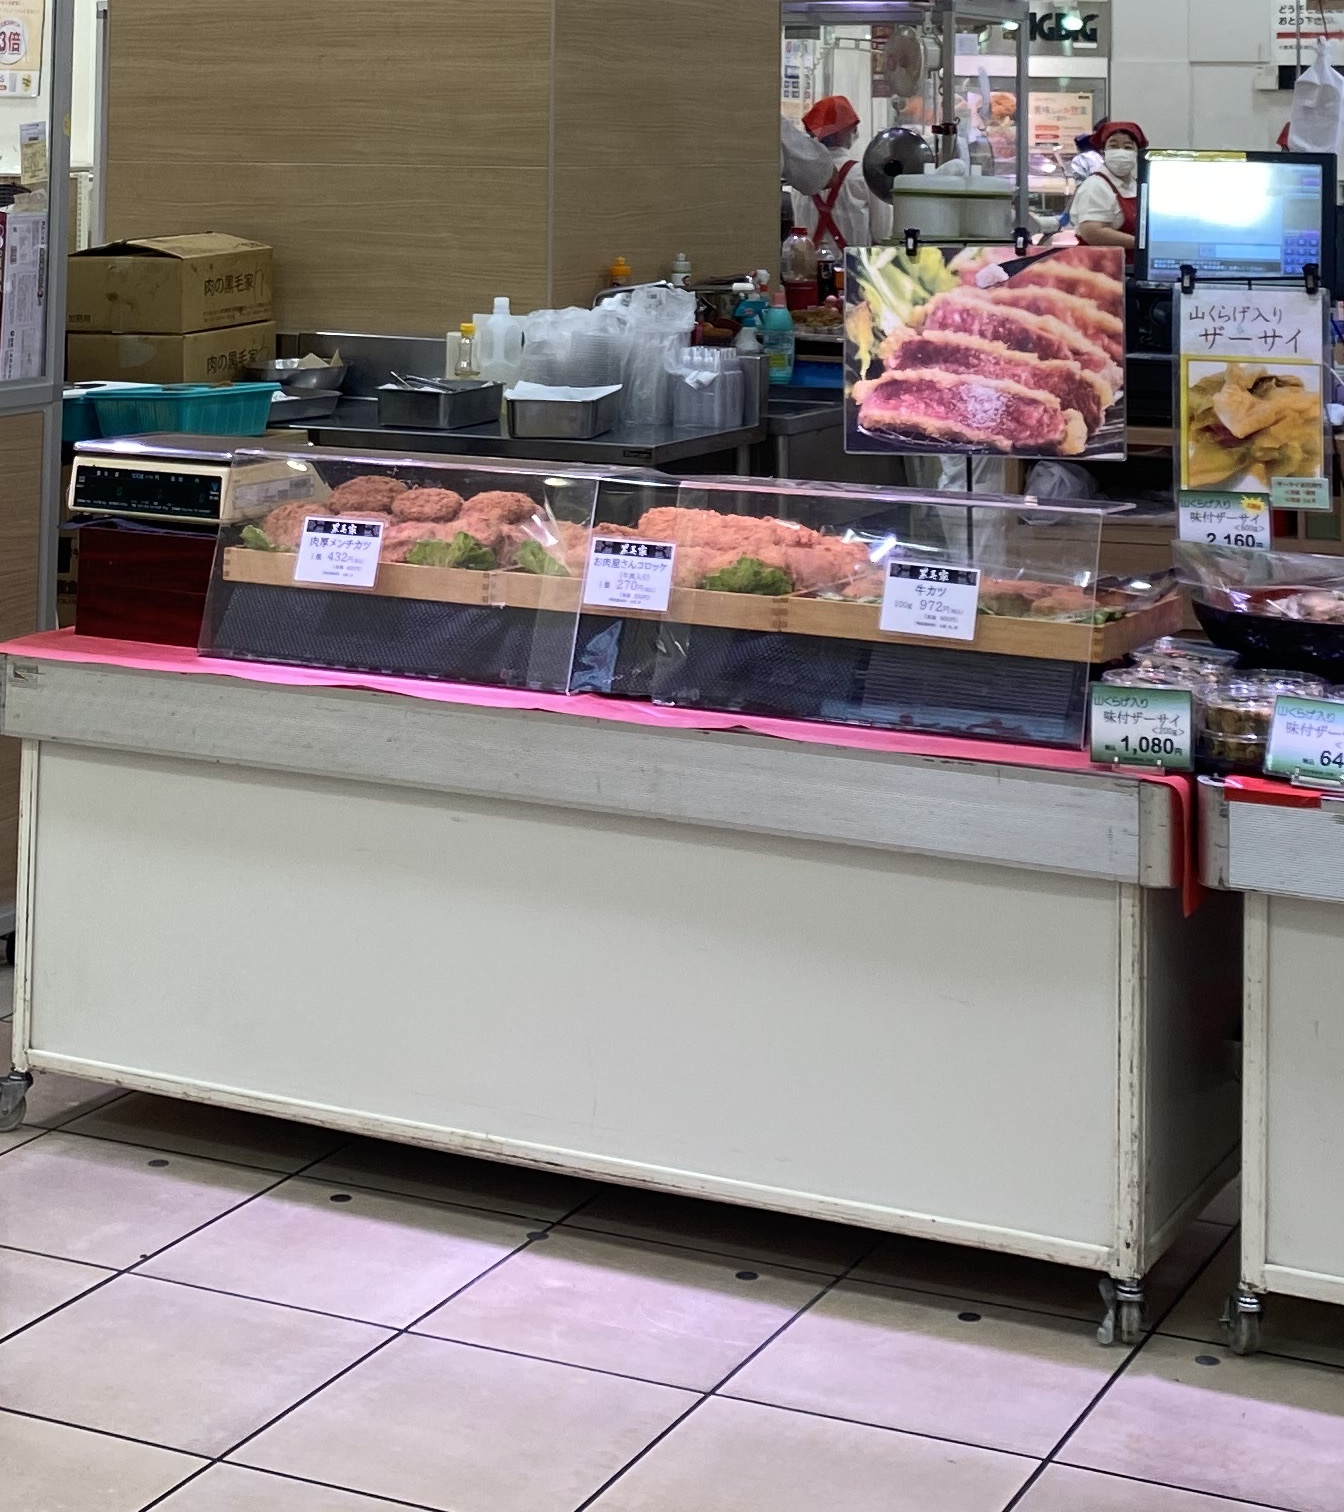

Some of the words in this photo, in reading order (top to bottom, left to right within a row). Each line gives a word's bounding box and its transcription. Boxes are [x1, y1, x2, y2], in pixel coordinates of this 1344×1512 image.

[203, 273, 256, 298] 肉の黒毛家
[1189, 304, 1283, 325] 山くらげ入り
[1198, 325, 1302, 354] ザーサイ
[206, 348, 259, 374] 肉の黒毛家
[1180, 498, 1232, 509] 山くらげ入り
[1189, 511, 1261, 525] 味付ザーサイ
[309, 536, 372, 551] 肉厚メンチカツ
[593, 557, 669, 572] お肉屋さんコロッケ
[914, 583, 948, 598] 牛カツ
[1093, 695, 1149, 709] 山くらげ入り
[1103, 709, 1181, 729] 味付ザーサイ
[1276, 705, 1336, 724] 山くらげ入り
[1120, 735, 1183, 757] 1,080円
